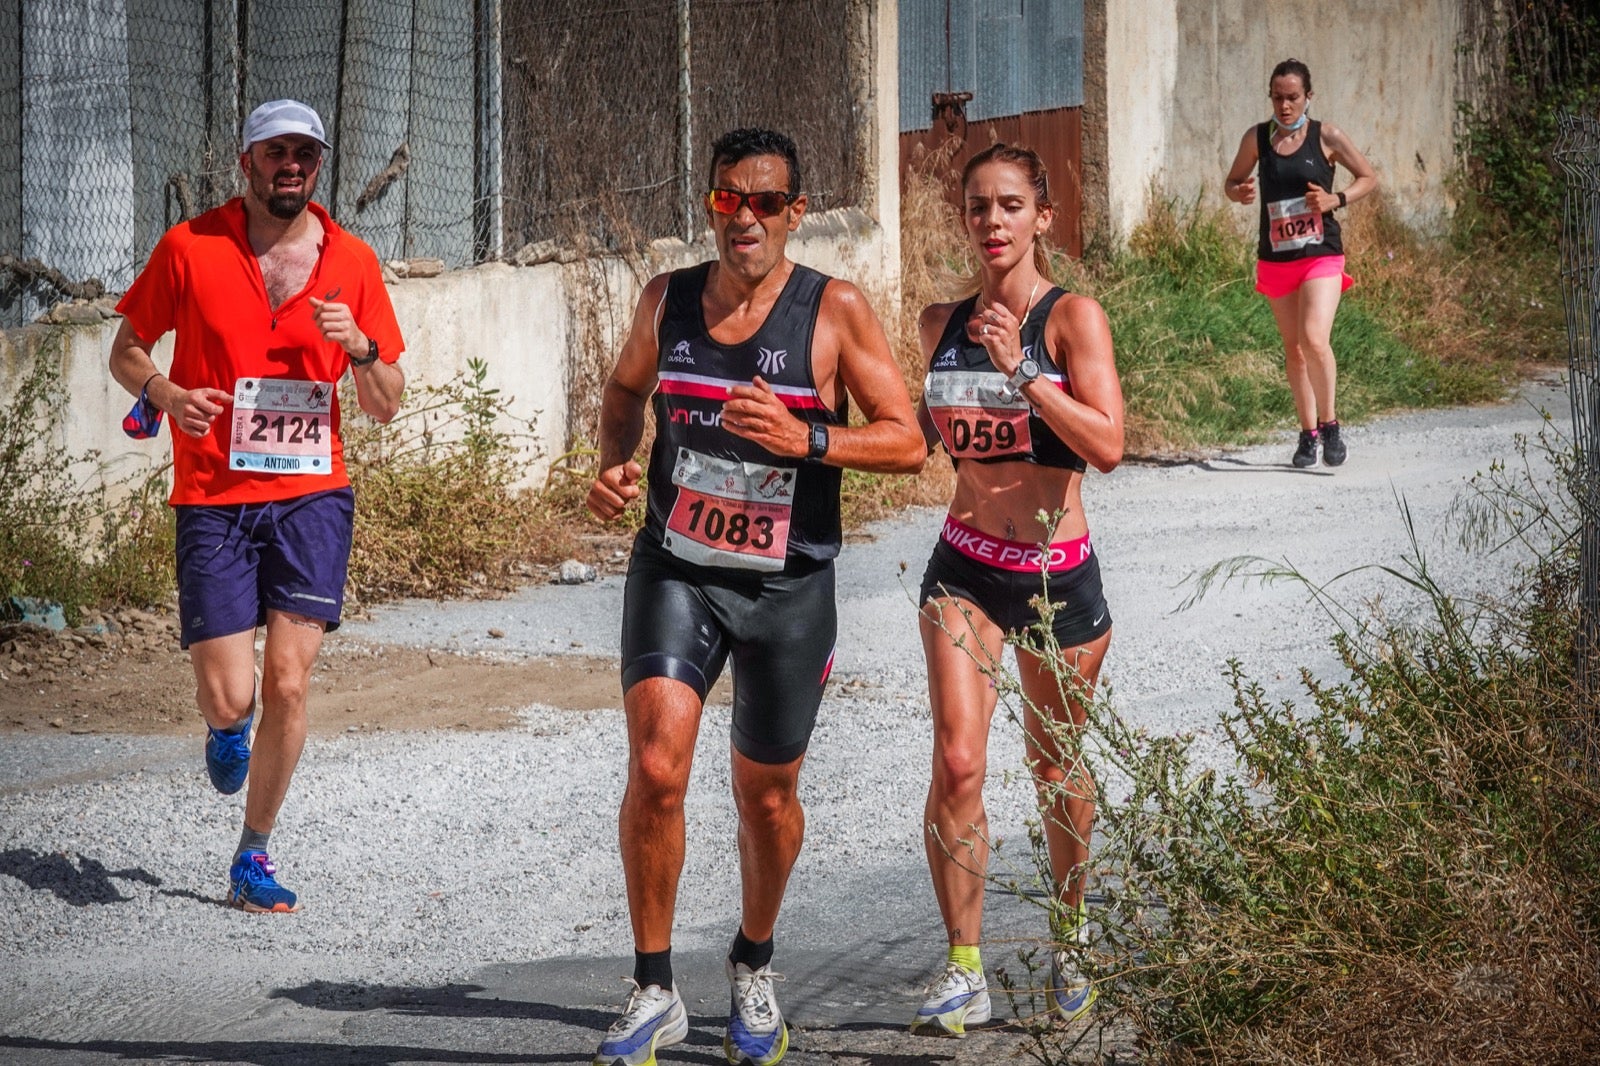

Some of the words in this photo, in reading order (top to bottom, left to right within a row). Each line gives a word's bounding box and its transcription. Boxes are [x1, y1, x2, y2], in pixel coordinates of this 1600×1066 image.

[1277, 217, 1317, 239] 1021
[249, 414, 322, 445] 2124
[263, 456, 300, 469] ANTONIO
[688, 499, 775, 550] 1083
[942, 522, 998, 559] NIKE
[998, 546, 1067, 566] PRO
